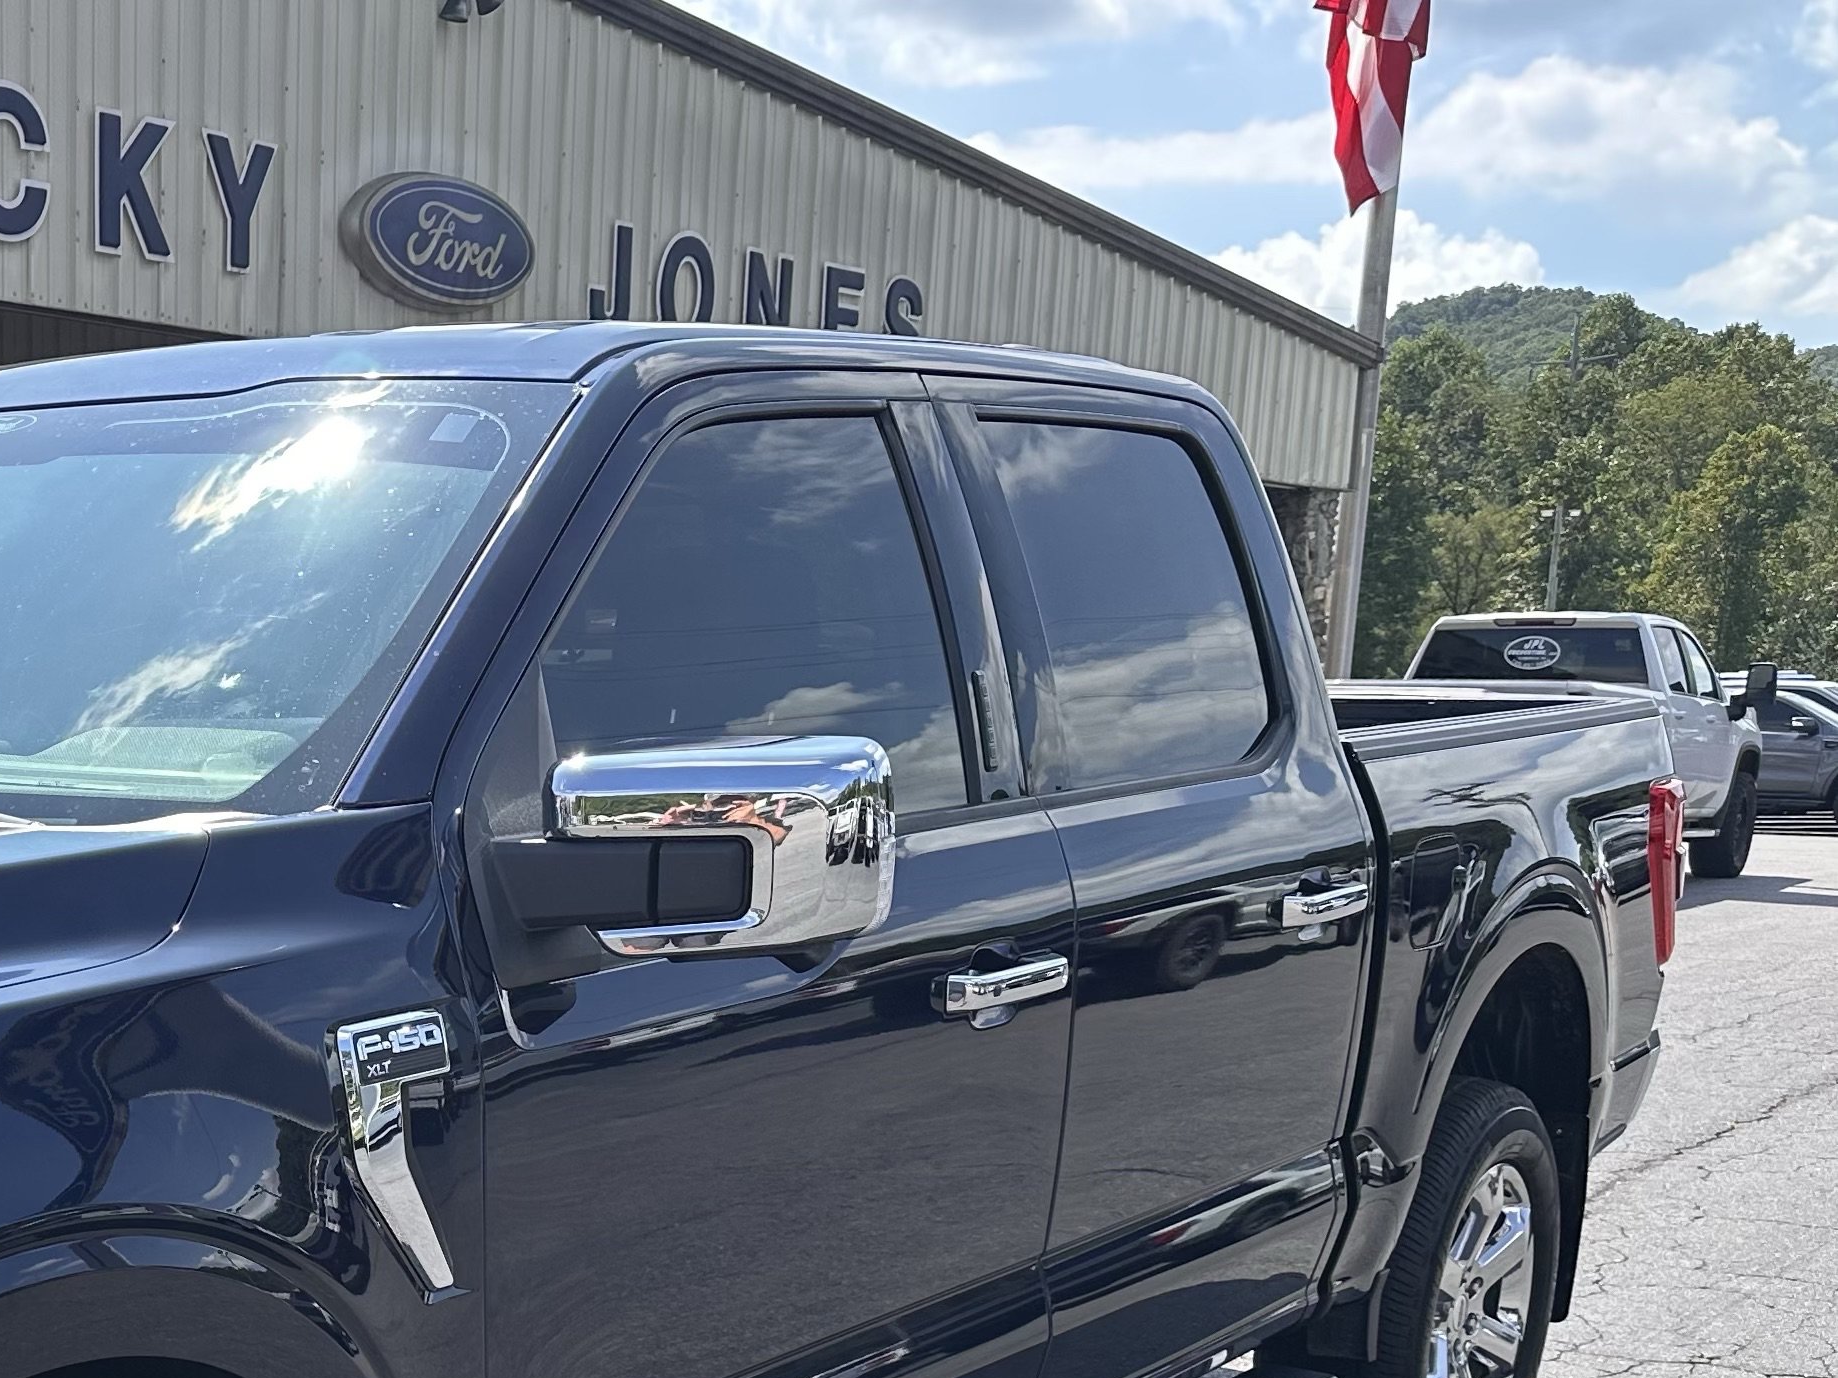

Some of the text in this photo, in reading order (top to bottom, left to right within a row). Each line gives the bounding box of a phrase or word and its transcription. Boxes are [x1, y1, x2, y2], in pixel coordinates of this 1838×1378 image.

[406, 200, 506, 281] Ford
[587, 220, 924, 336] JONES
[366, 1059, 393, 1078] XLT
